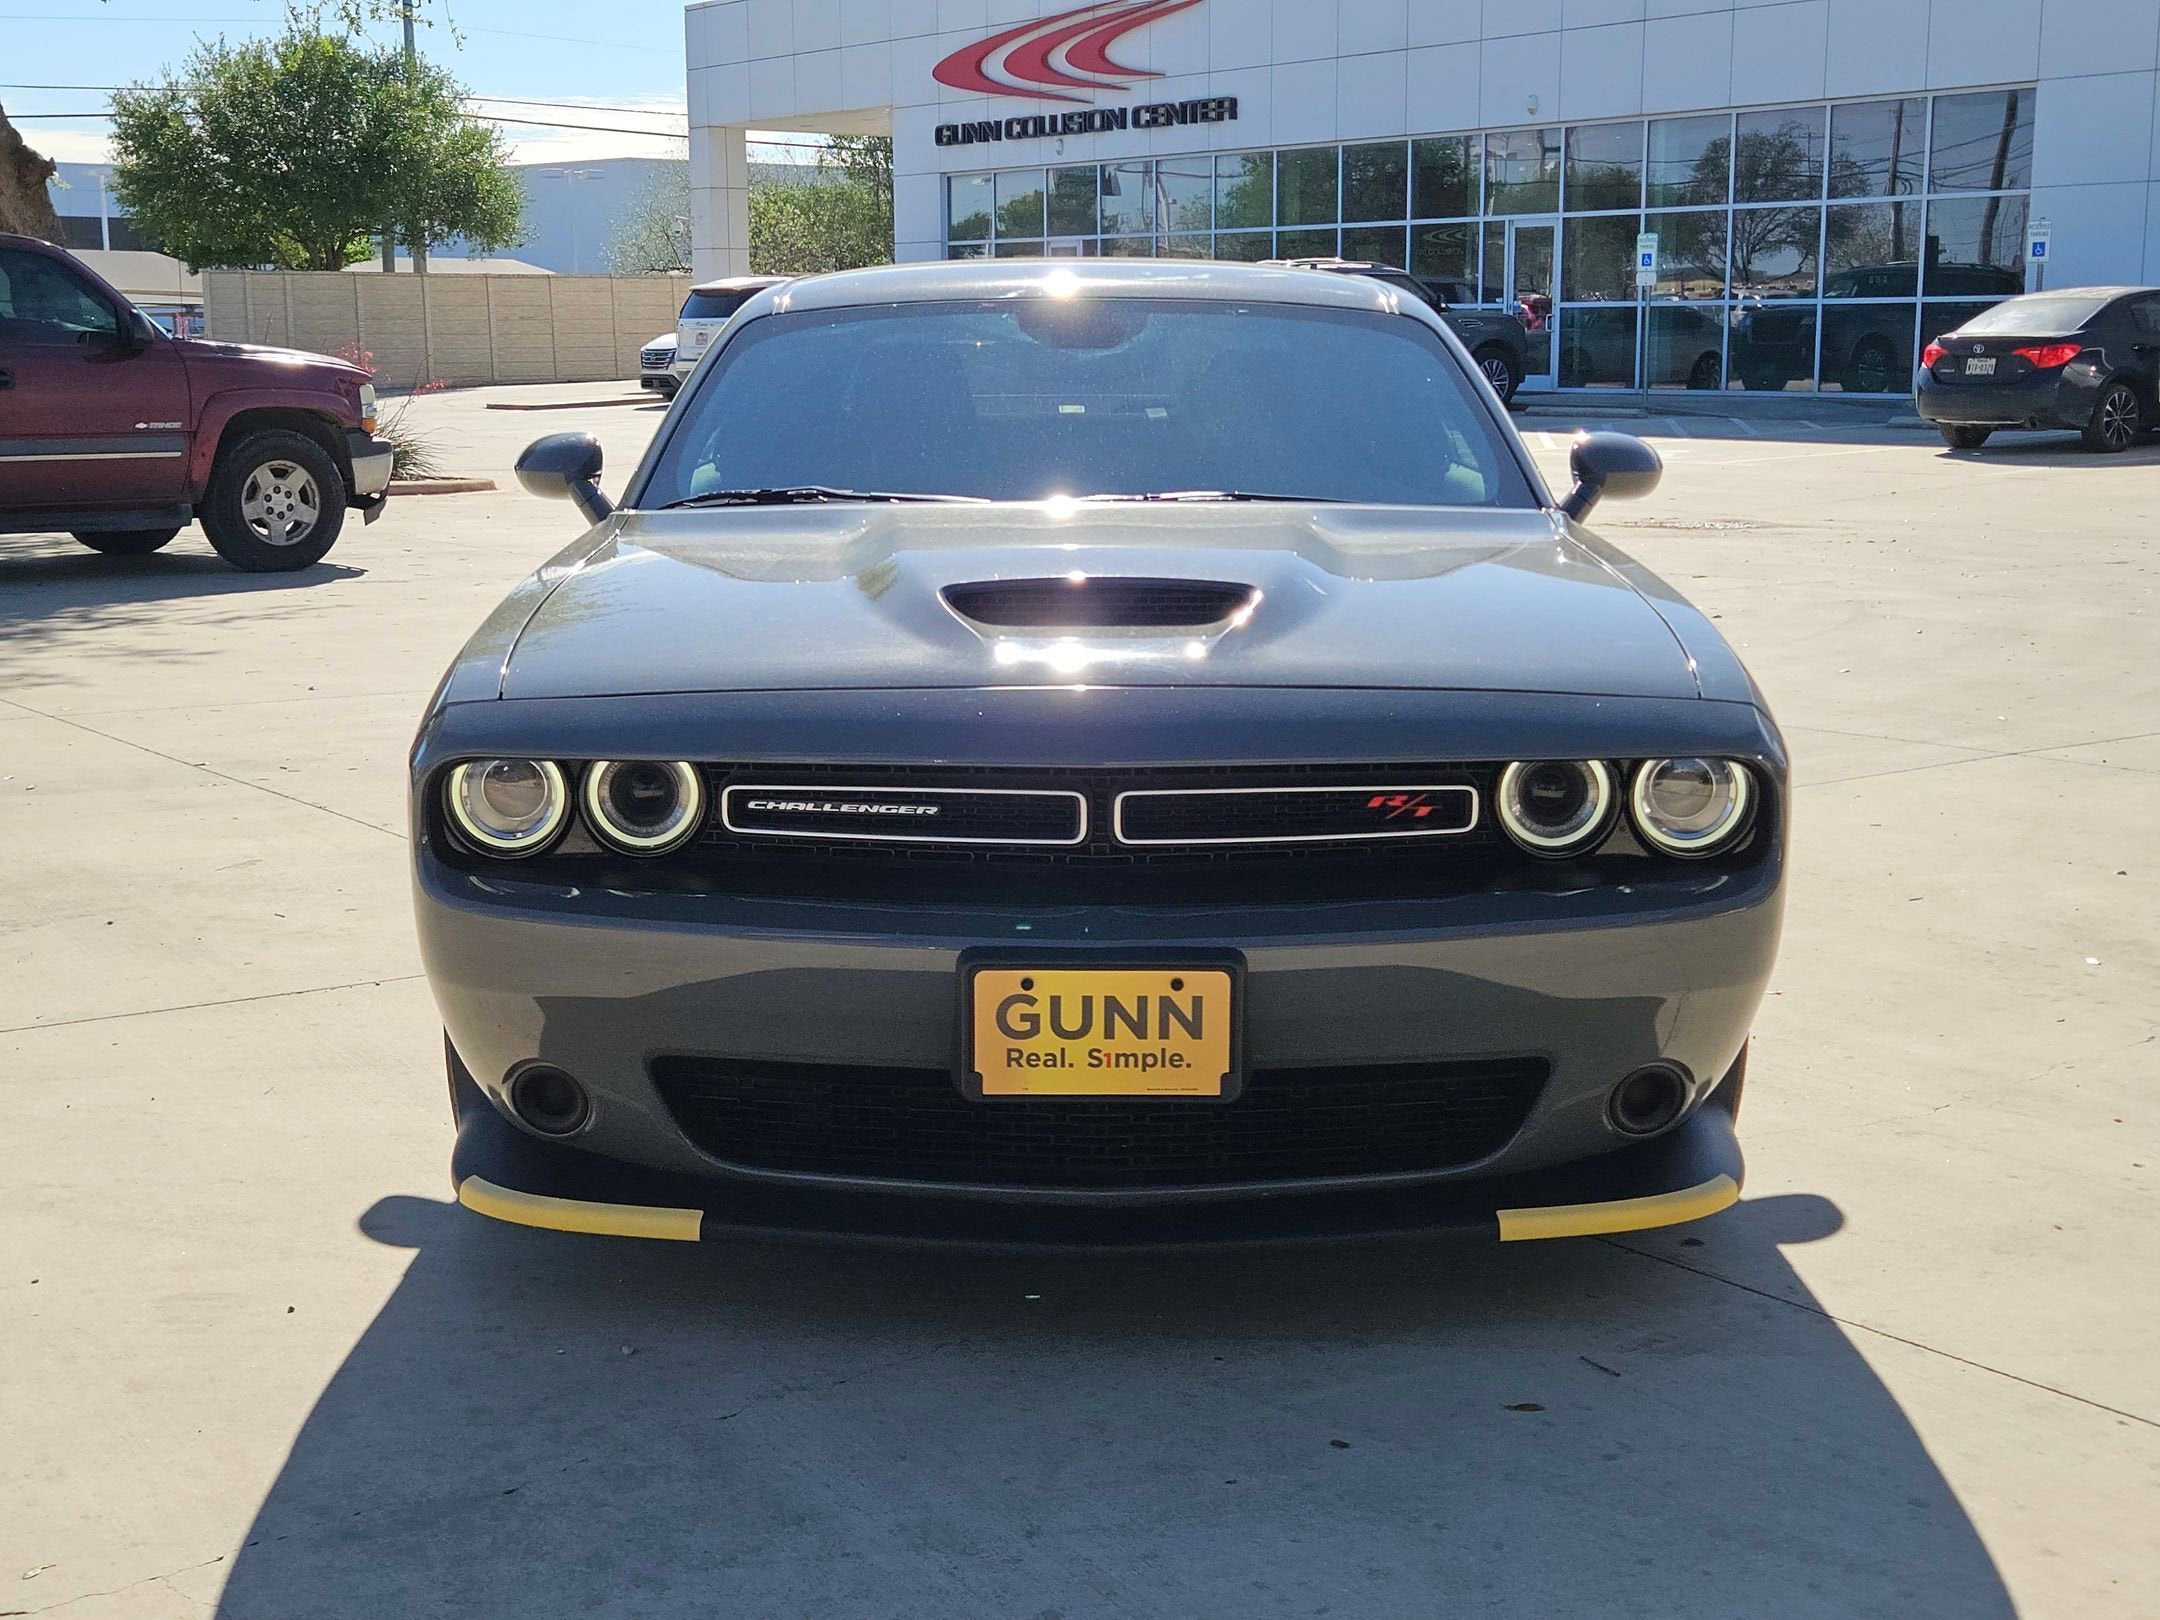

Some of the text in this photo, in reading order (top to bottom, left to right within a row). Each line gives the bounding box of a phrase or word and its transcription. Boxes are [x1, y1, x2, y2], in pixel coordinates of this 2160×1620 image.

[934, 97, 1238, 147] GUNN COLLISION CENTER
[748, 801, 938, 815] CHALLENGER
[1367, 793, 1441, 820] R/T
[995, 993, 1204, 1040] GUNN
[1006, 1047, 1075, 1068] Real.
